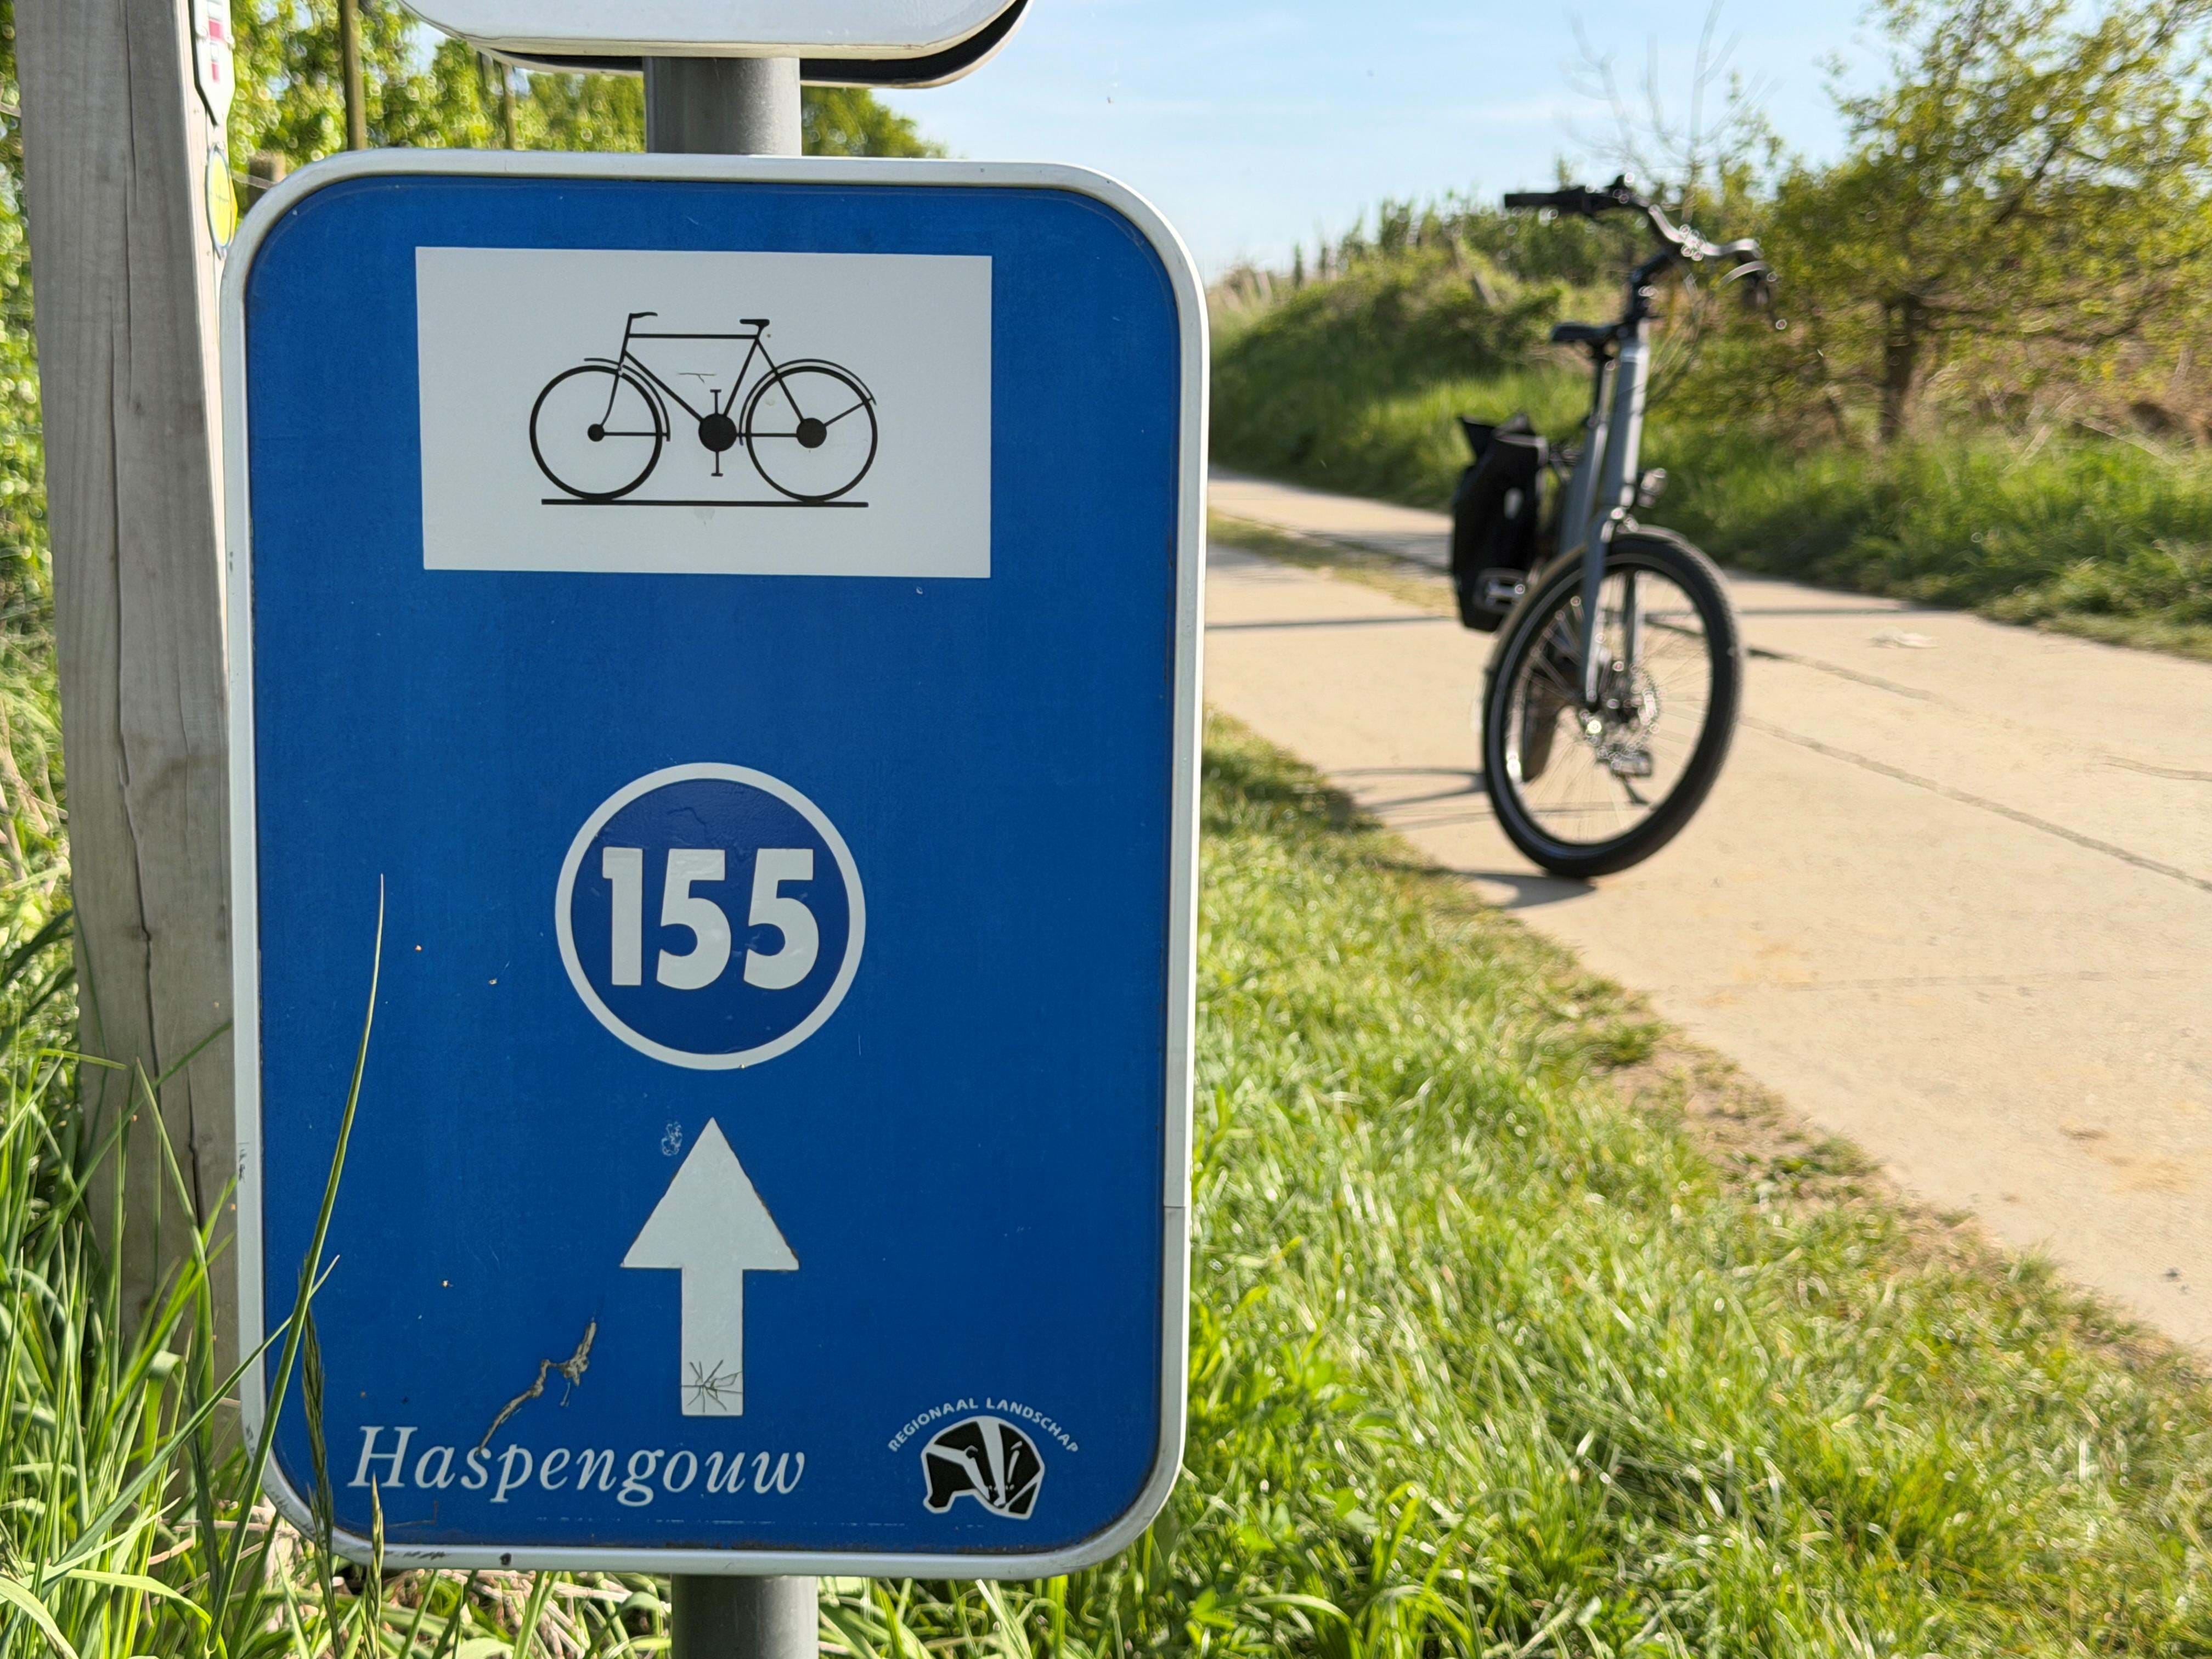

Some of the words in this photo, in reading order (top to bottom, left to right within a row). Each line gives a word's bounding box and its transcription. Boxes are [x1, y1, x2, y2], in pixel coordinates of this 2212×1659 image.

[602, 847, 819, 990] 155
[347, 1425, 805, 1507] Haspengouw
[888, 1397, 979, 1452] REGIONAAL
[986, 1397, 1079, 1453] LANDSCHAP
